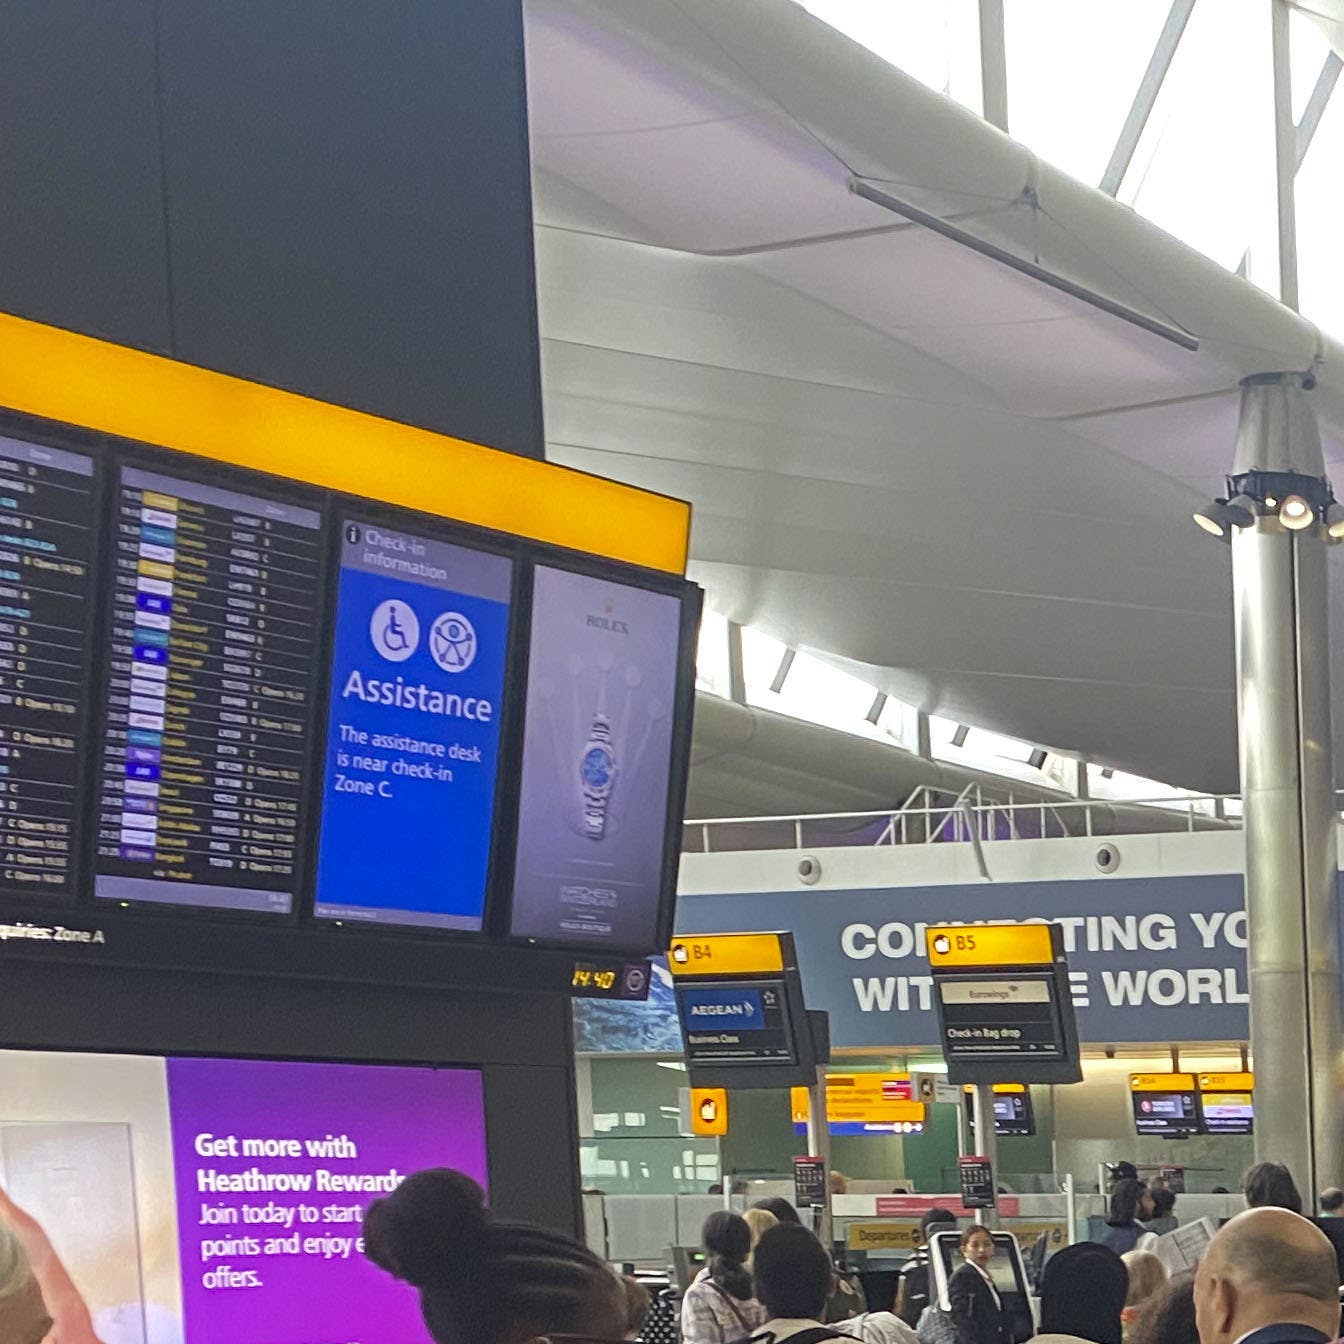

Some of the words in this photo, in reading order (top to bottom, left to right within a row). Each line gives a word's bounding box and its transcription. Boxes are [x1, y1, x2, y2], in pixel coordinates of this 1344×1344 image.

[365, 530, 425, 555] Check-in
[362, 549, 447, 580] information
[586, 614, 630, 635] ROLEX
[342, 670, 493, 722] Assistance
[339, 724, 368, 745] The
[371, 732, 445, 757] assistance
[448, 743, 481, 763] desk
[336, 750, 349, 767] is
[352, 755, 389, 772] near
[391, 758, 453, 781] check-in
[334, 774, 374, 796] Zone
[54, 926, 92, 942] Zone
[92, 930, 105, 944] A
[956, 935, 976, 950] B5
[692, 943, 711, 960] B4
[853, 975, 934, 1012] WIT
[1101, 969, 1250, 1007] WORL
[691, 1004, 742, 1016] AEGEAN
[194, 1133, 239, 1157] Get
[242, 1138, 301, 1157] more
[305, 1134, 357, 1159] with
[197, 1167, 312, 1192] Heathrow
[199, 1202, 238, 1225] Join
[242, 1201, 295, 1228] today
[299, 1204, 319, 1223] to
[322, 1204, 364, 1223] start
[201, 1234, 261, 1262] points
[264, 1232, 300, 1255] and
[303, 1232, 354, 1259] enjoy
[202, 1266, 263, 1289] offers.
